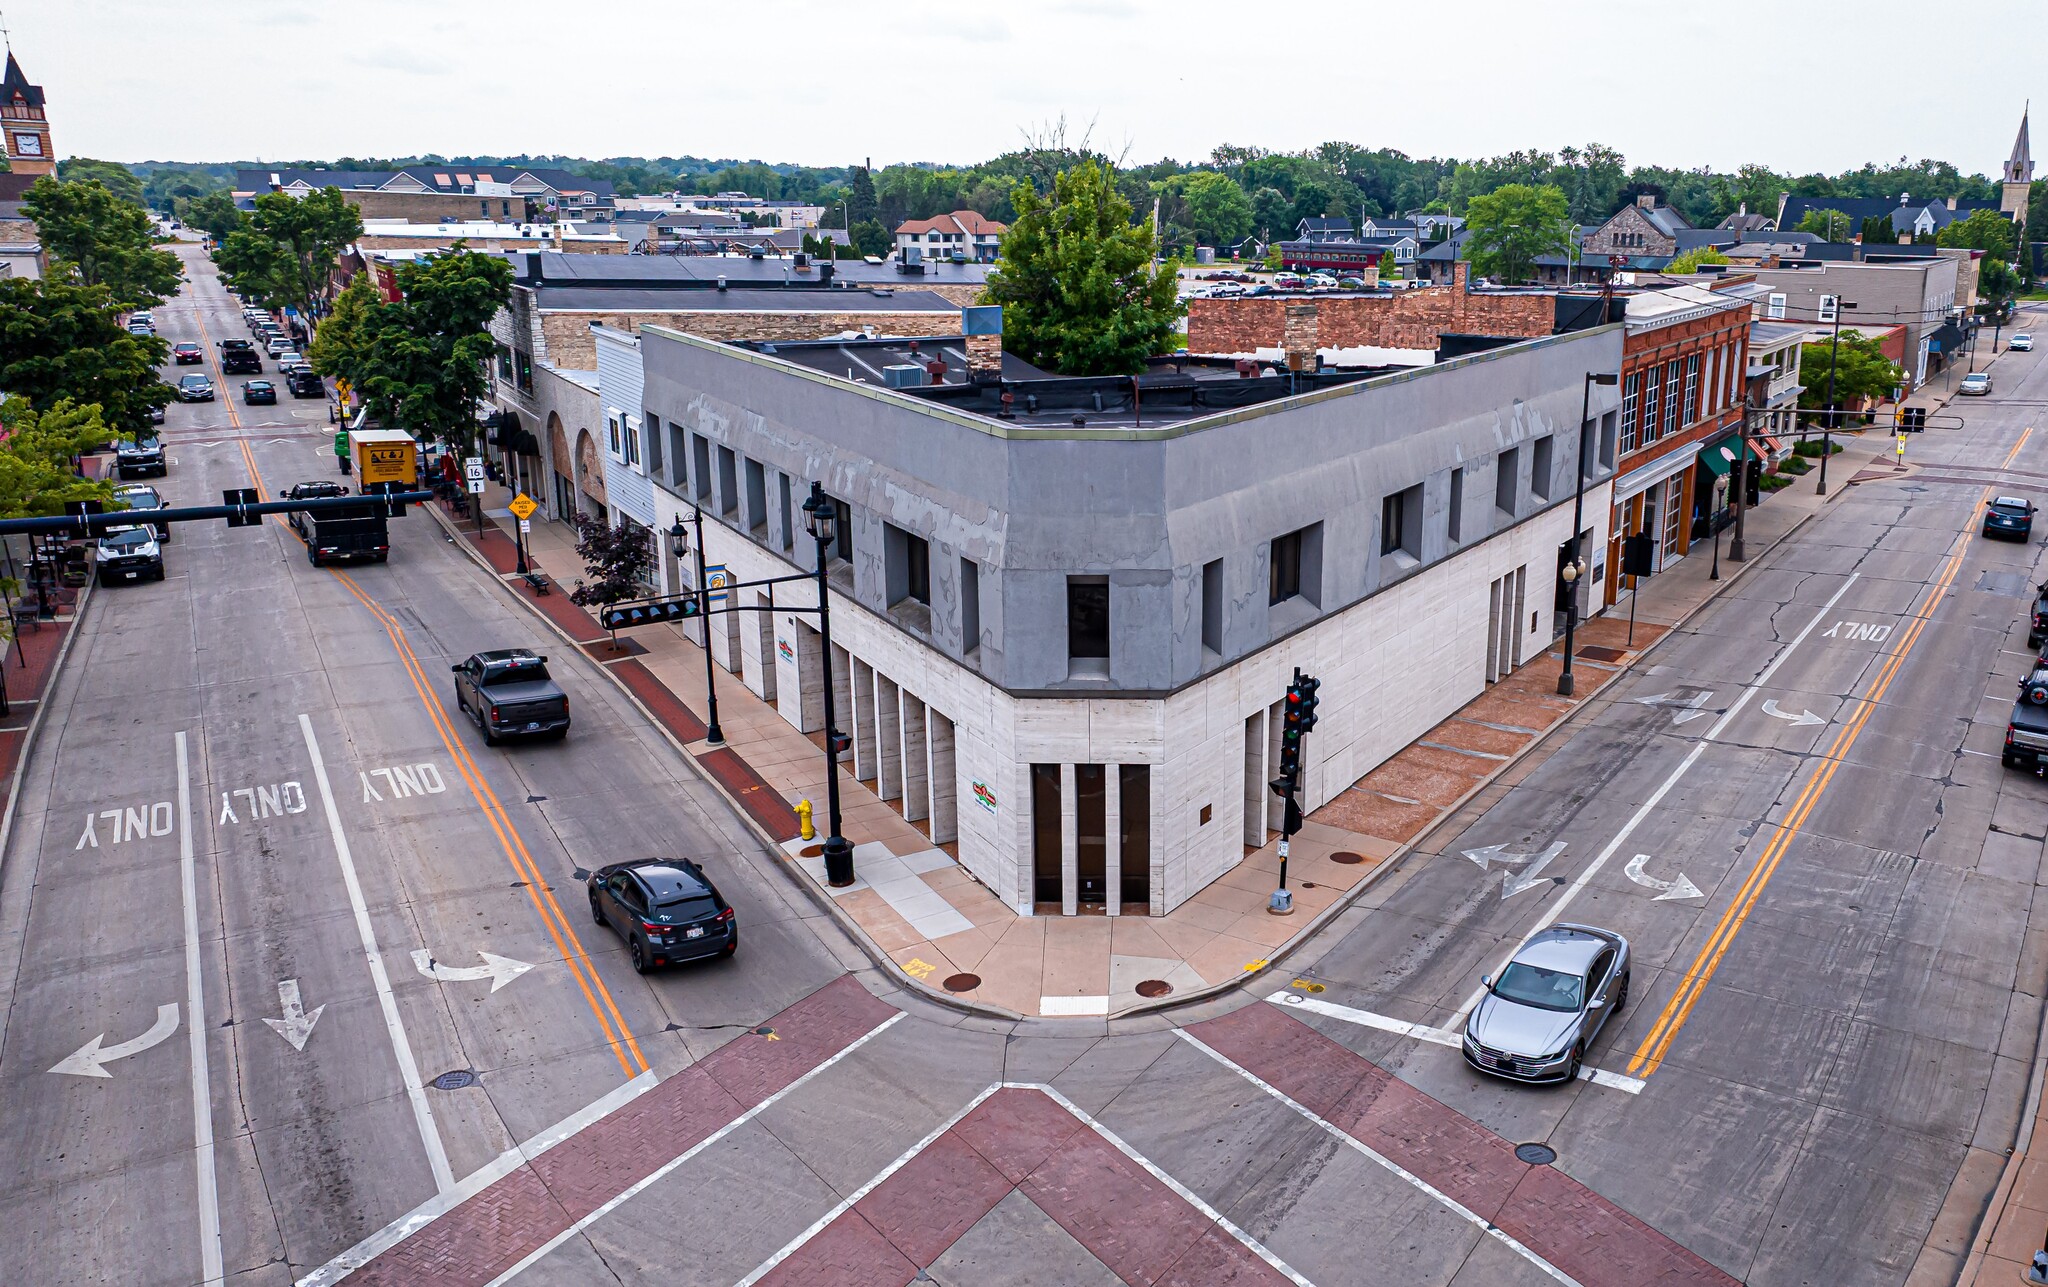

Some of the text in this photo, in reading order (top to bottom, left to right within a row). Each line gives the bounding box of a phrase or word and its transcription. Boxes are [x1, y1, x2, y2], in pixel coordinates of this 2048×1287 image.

[389, 451, 397, 459] &
[470, 468, 480, 477] 16
[1822, 621, 1892, 642] ONLY
[359, 763, 447, 803] ONLY
[219, 781, 307, 825] ONLY
[75, 801, 173, 850] ONLY
